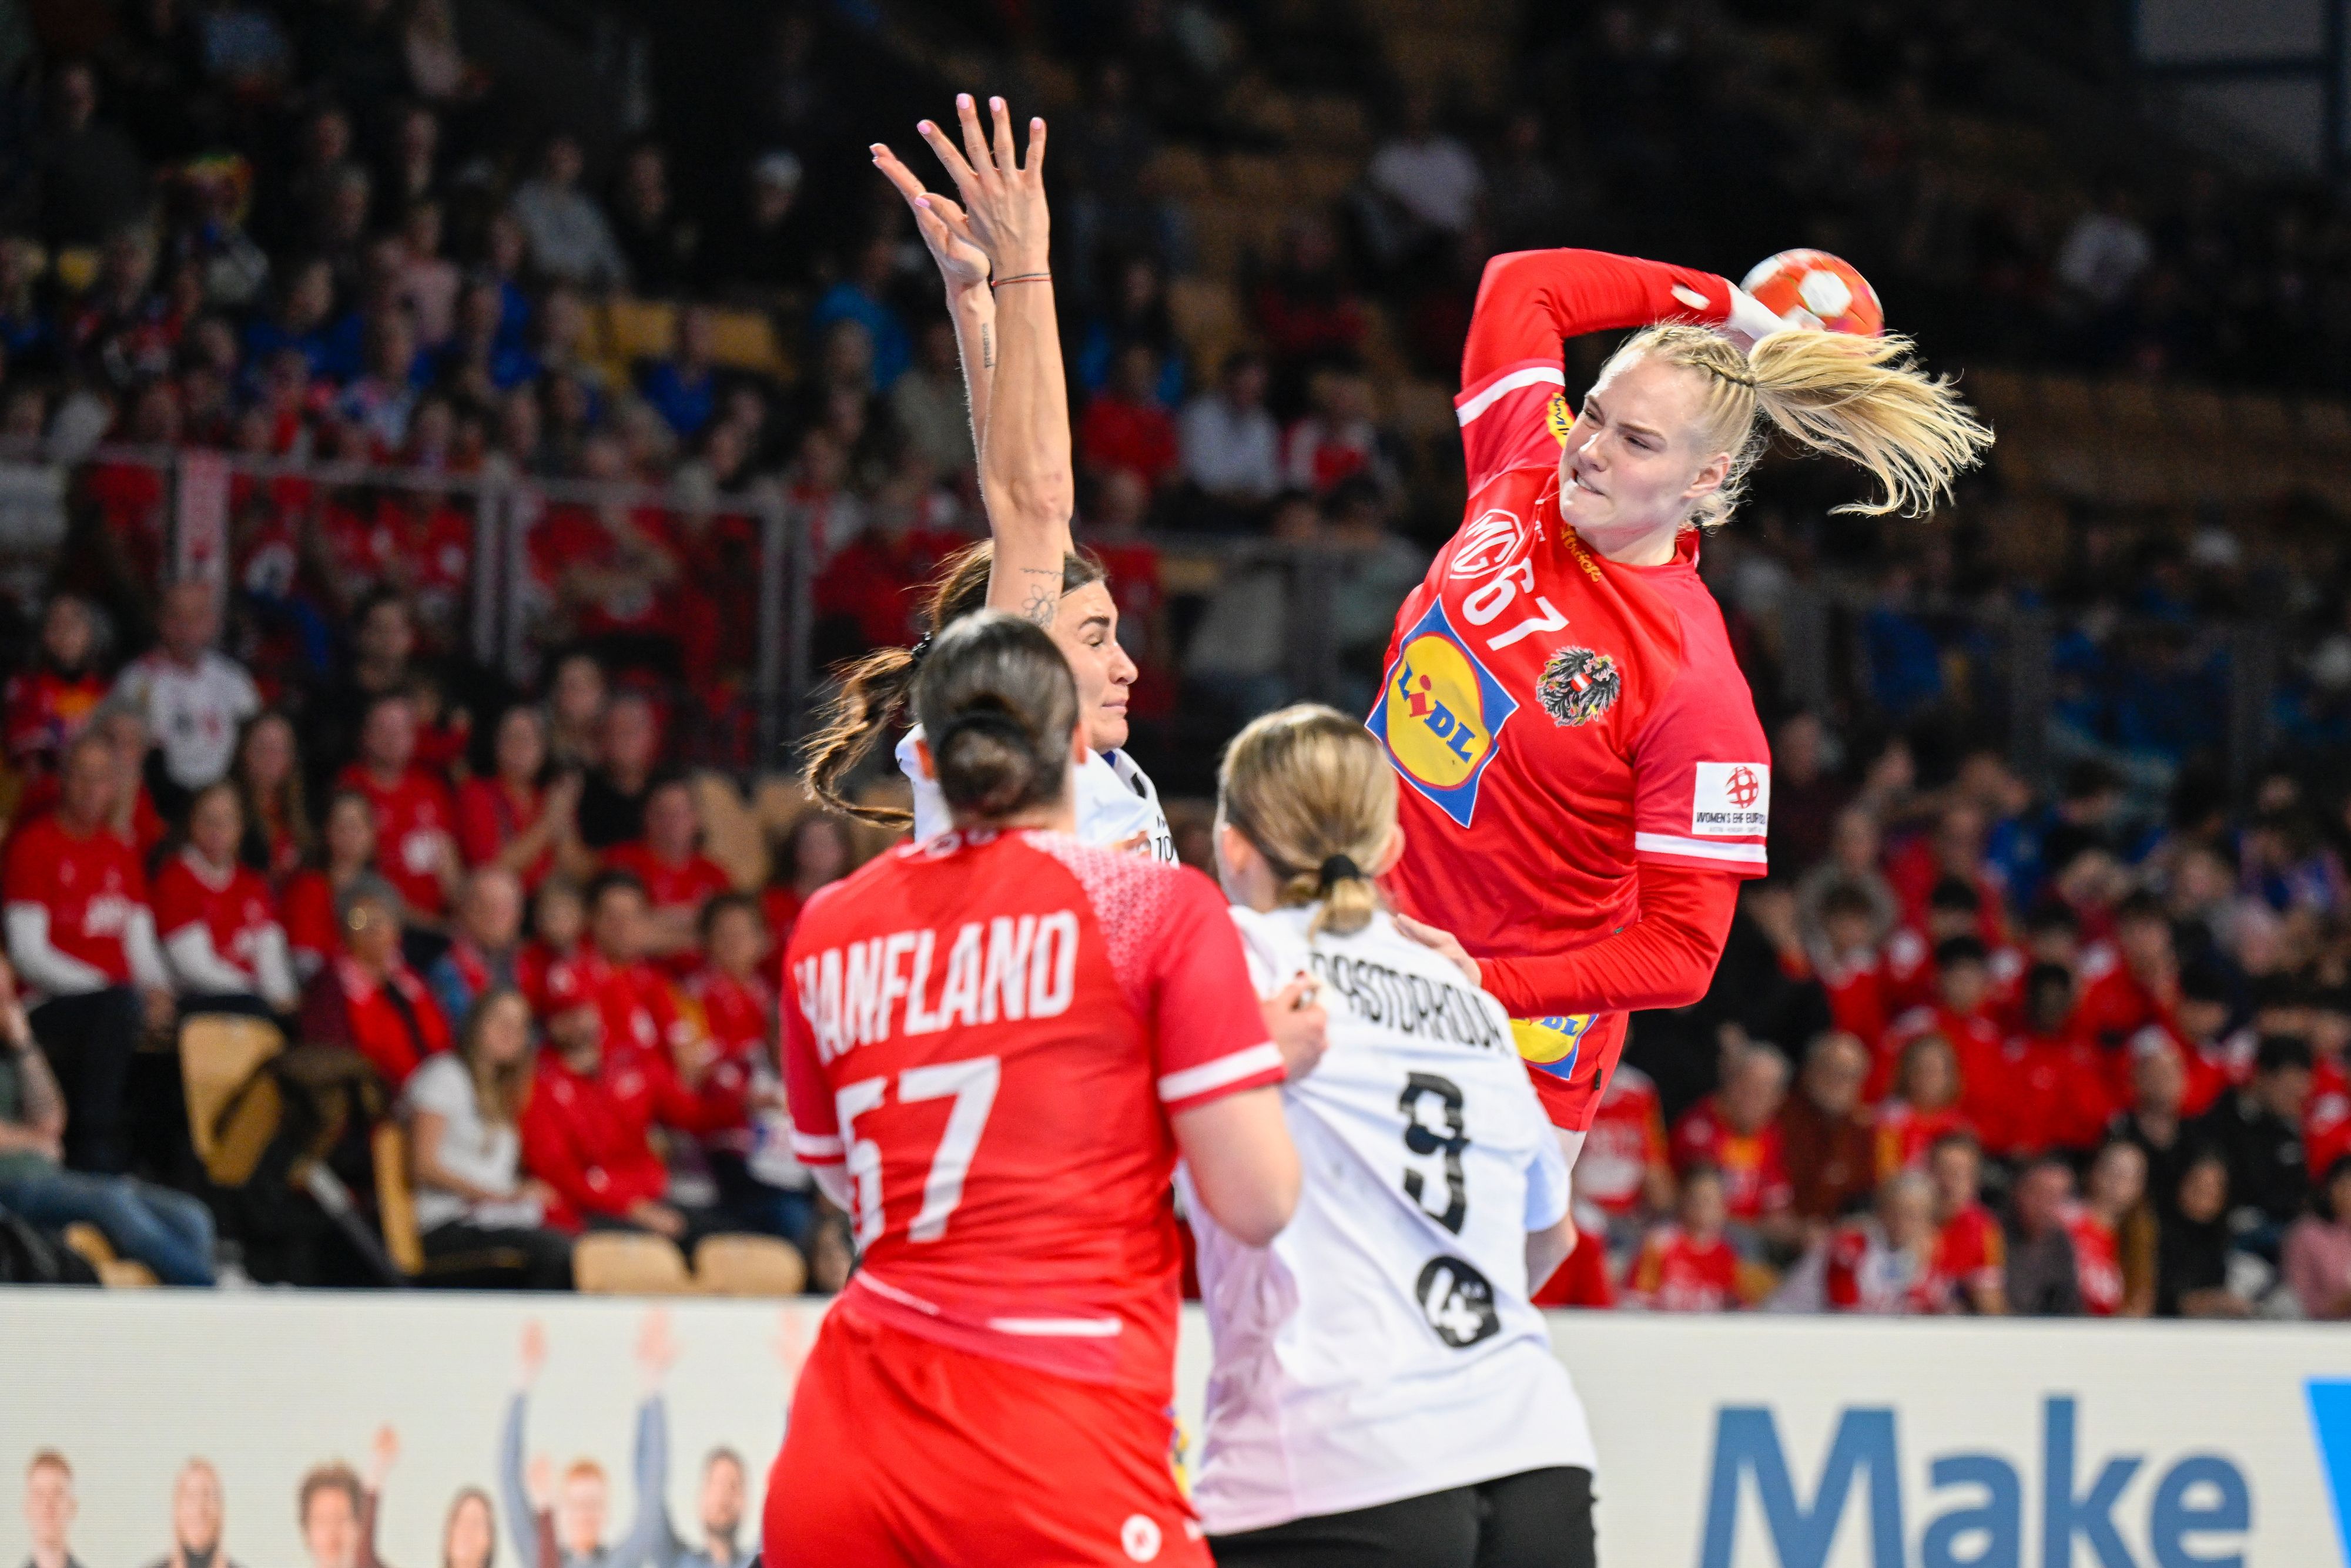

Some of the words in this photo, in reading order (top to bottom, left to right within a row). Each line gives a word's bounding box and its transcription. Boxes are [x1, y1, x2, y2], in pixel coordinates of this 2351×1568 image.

[1454, 515, 1517, 572] MG
[1462, 557, 1570, 651] 67
[1156, 836, 1174, 861] 10
[793, 910, 1080, 1067] HANFLAND
[1399, 1072, 1469, 1235] 9
[1700, 1393, 2253, 1568] Make
